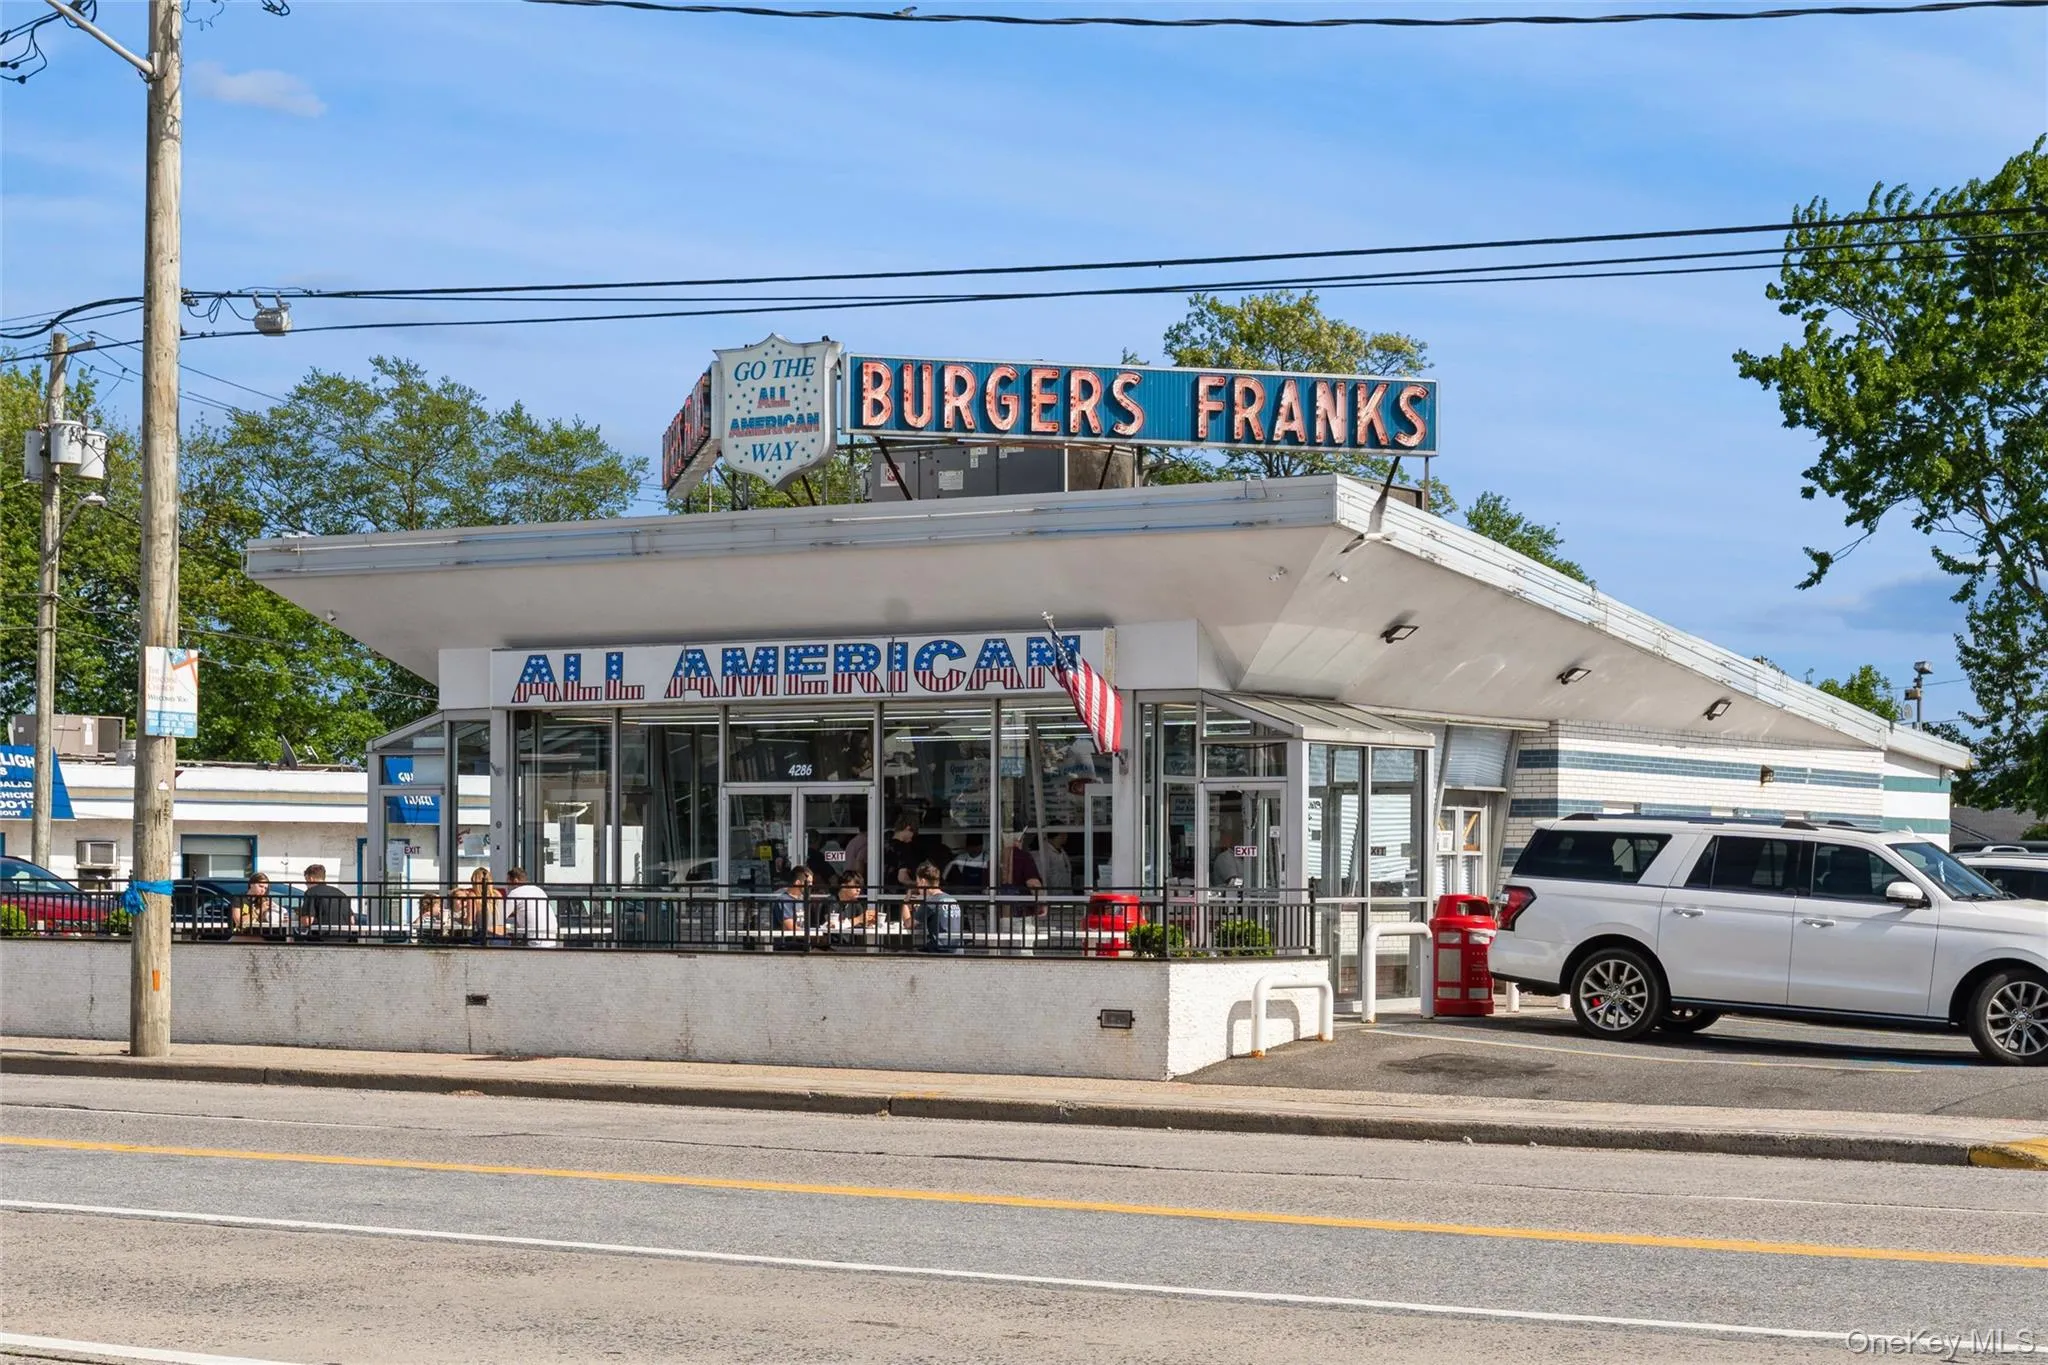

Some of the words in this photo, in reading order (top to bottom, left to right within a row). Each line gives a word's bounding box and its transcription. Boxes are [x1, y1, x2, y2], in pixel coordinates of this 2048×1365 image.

[734, 360, 767, 382] GO
[772, 356, 817, 379] THE
[757, 385, 791, 409] ALL
[862, 360, 1145, 436] BURGERS
[1197, 374, 1430, 448] FRANKS
[728, 412, 820, 439] AMERICAN
[751, 440, 800, 463] WAY
[511, 651, 645, 703] ALL
[664, 634, 1081, 699] AMERICAN
[0, 752, 35, 768] LIGH
[788, 764, 813, 776] 4286
[0, 791, 34, 799] HICKE
[404, 846, 421, 855] EXIT
[826, 851, 845, 861] EXIT
[1235, 846, 1257, 856] EXIT
[1370, 846, 1386, 856] XIT
